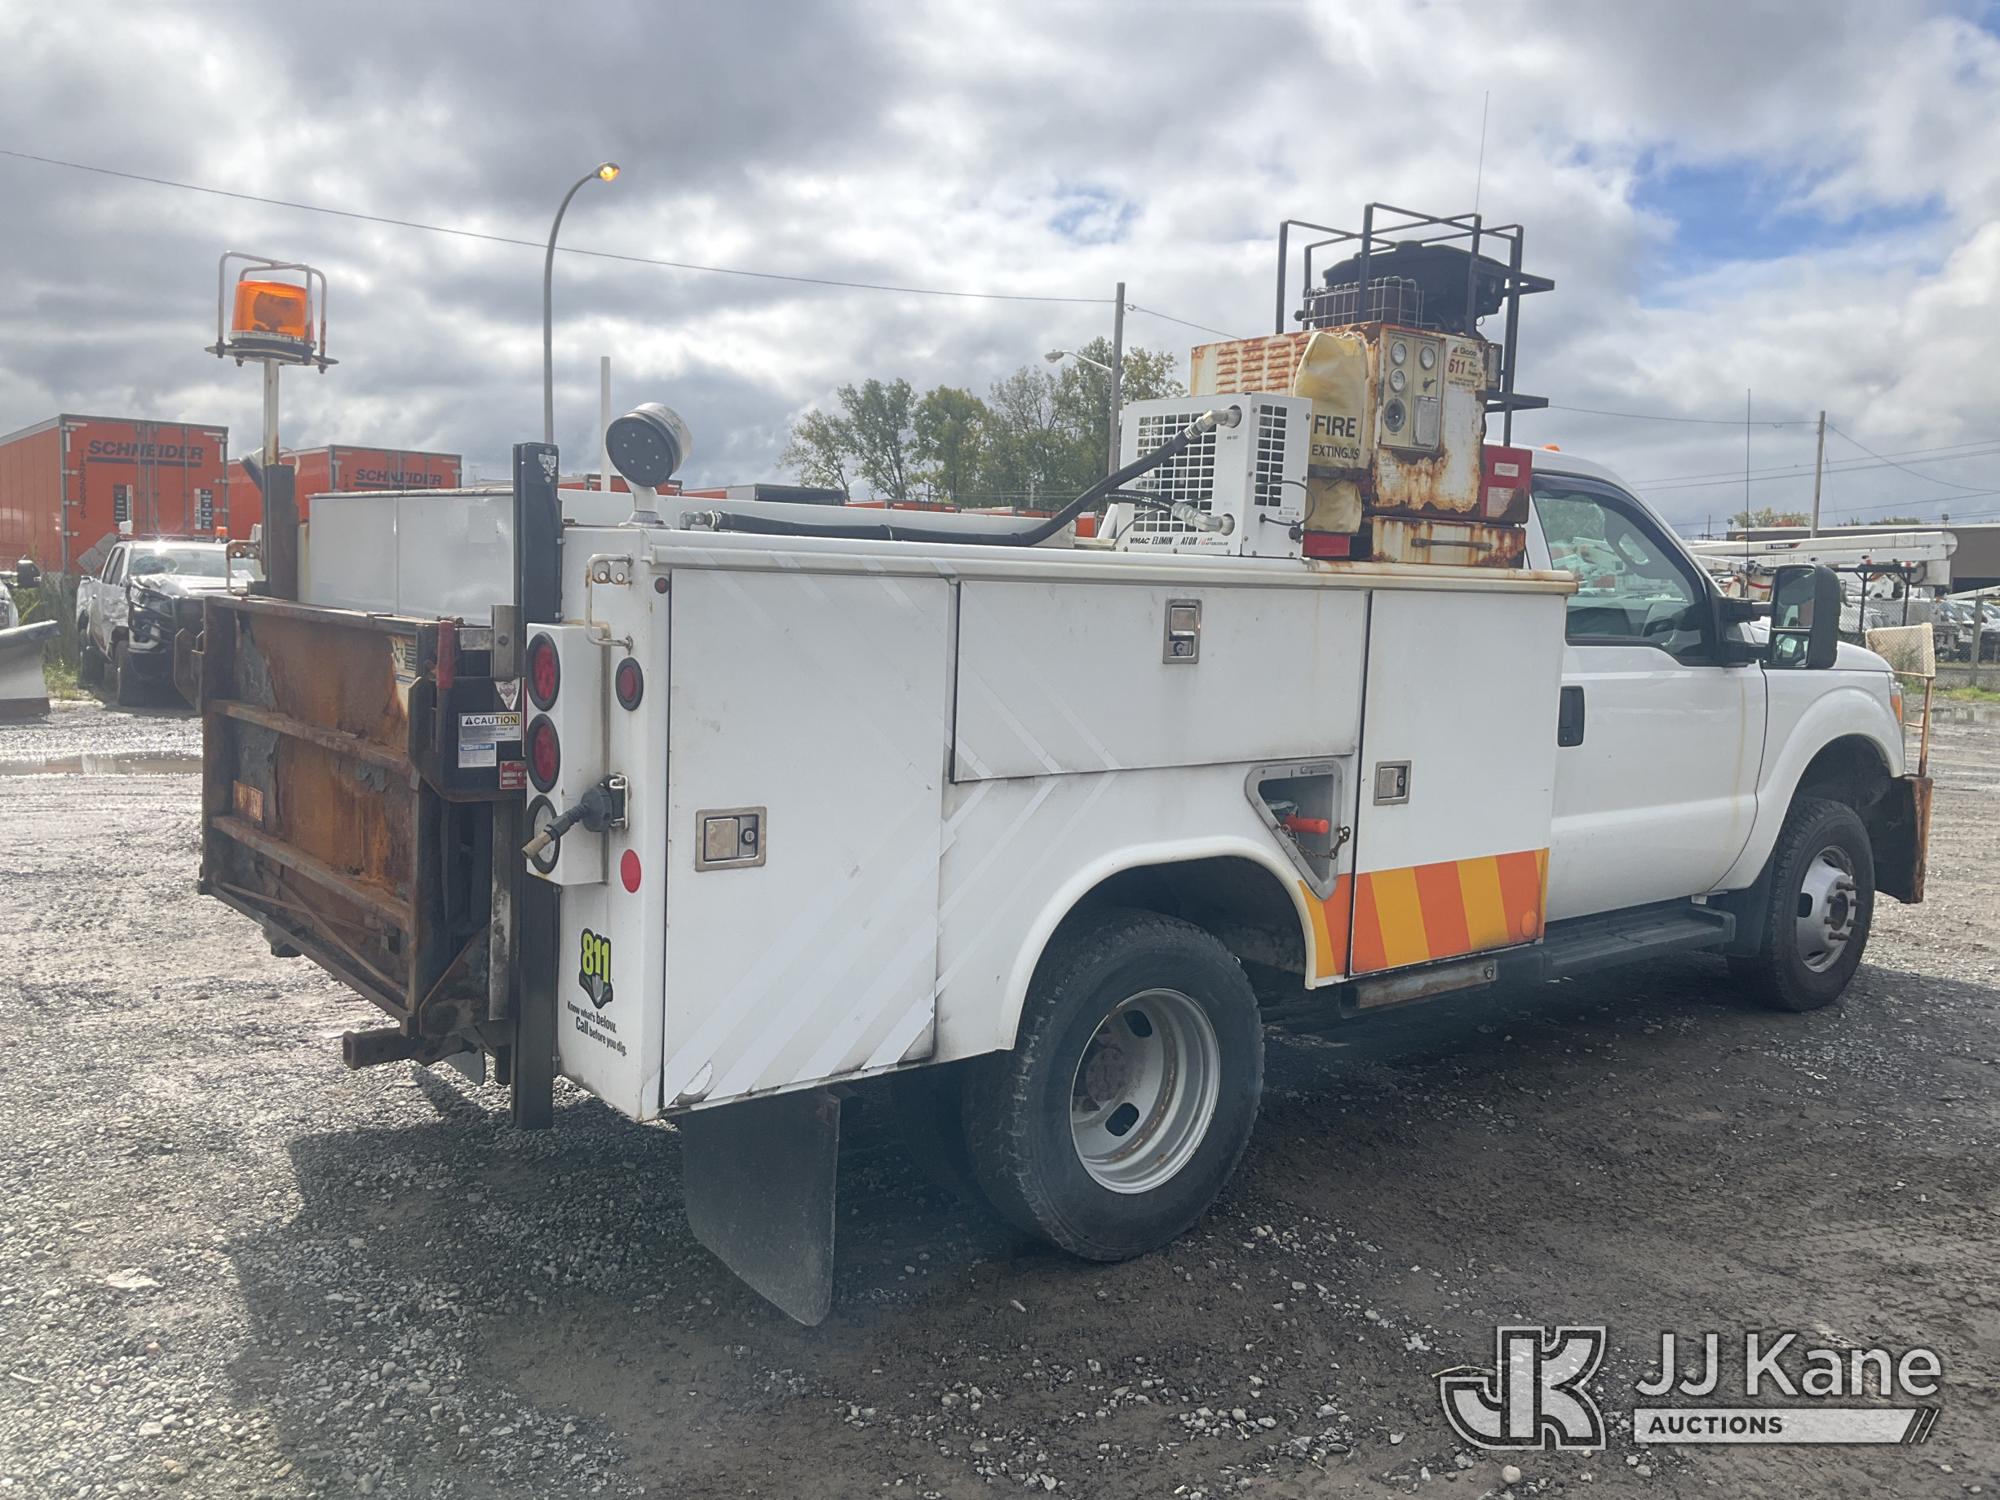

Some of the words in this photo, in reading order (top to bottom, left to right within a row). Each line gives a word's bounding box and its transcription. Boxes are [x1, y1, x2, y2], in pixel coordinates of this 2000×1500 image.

[1313, 414, 1357, 438] FIRE
[88, 440, 204, 460] SCHNEIDER
[355, 468, 443, 486] SCHNEIDER
[474, 716, 517, 725] CAUTION
[581, 929, 611, 984] 811
[576, 1017, 588, 1034] Call
